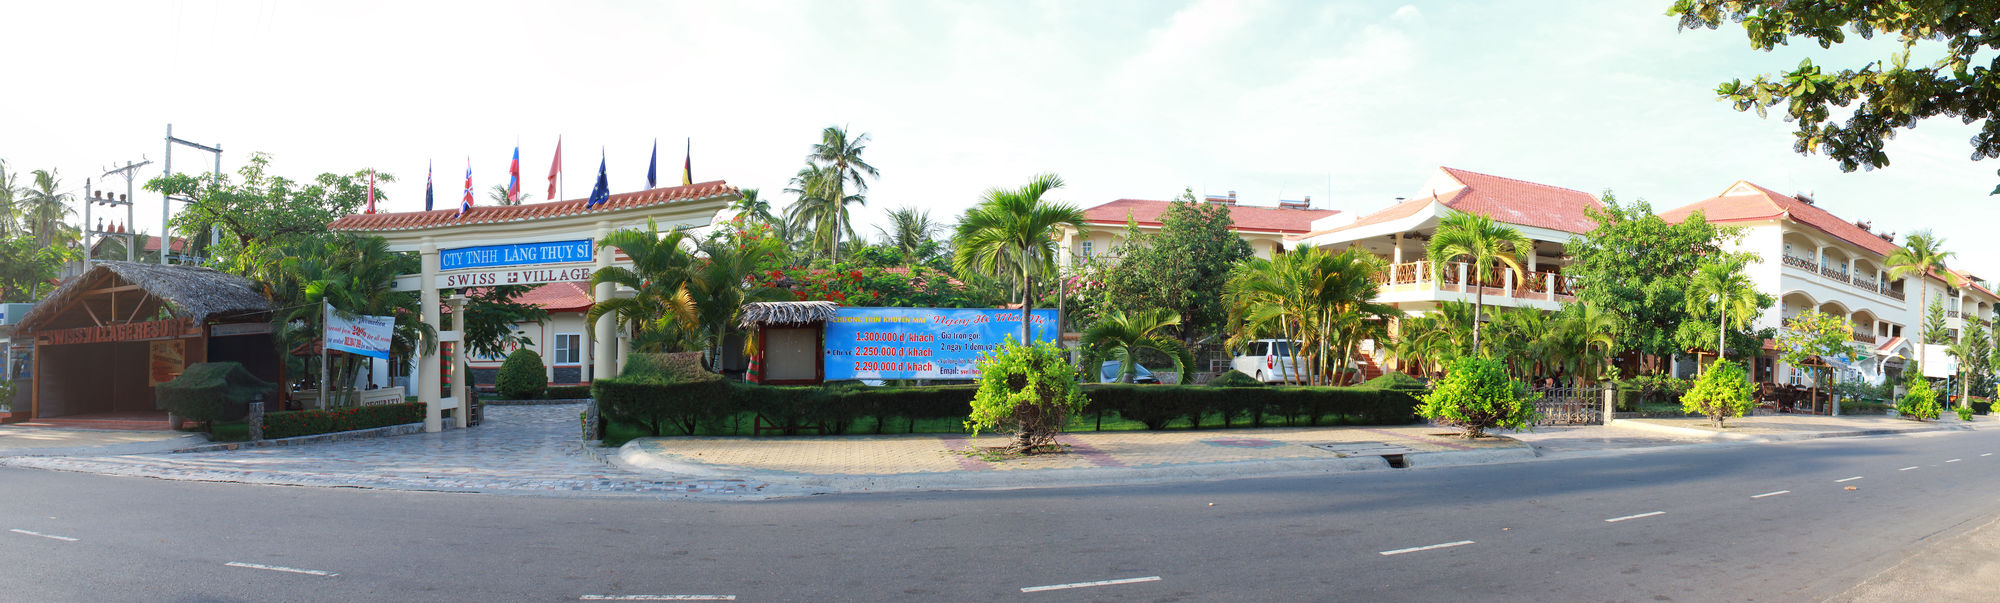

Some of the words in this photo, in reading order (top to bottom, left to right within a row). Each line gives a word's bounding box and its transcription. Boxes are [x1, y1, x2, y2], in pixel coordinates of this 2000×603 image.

[443, 251, 464, 267] CTY
[466, 249, 498, 265] TNHH
[504, 244, 537, 262] LÀNG
[540, 244, 573, 262] THỤY
[577, 240, 590, 258] SĨ
[448, 272, 496, 287] SWISS
[522, 268, 591, 282] VILLAGE
[48, 329, 83, 345] SWISS
[84, 323, 133, 343] VILLAGE
[134, 317, 187, 340] RESORT
[856, 332, 897, 342] 1.300.000
[855, 346, 897, 356] 2.250.000
[854, 361, 896, 371] 2.290.000
